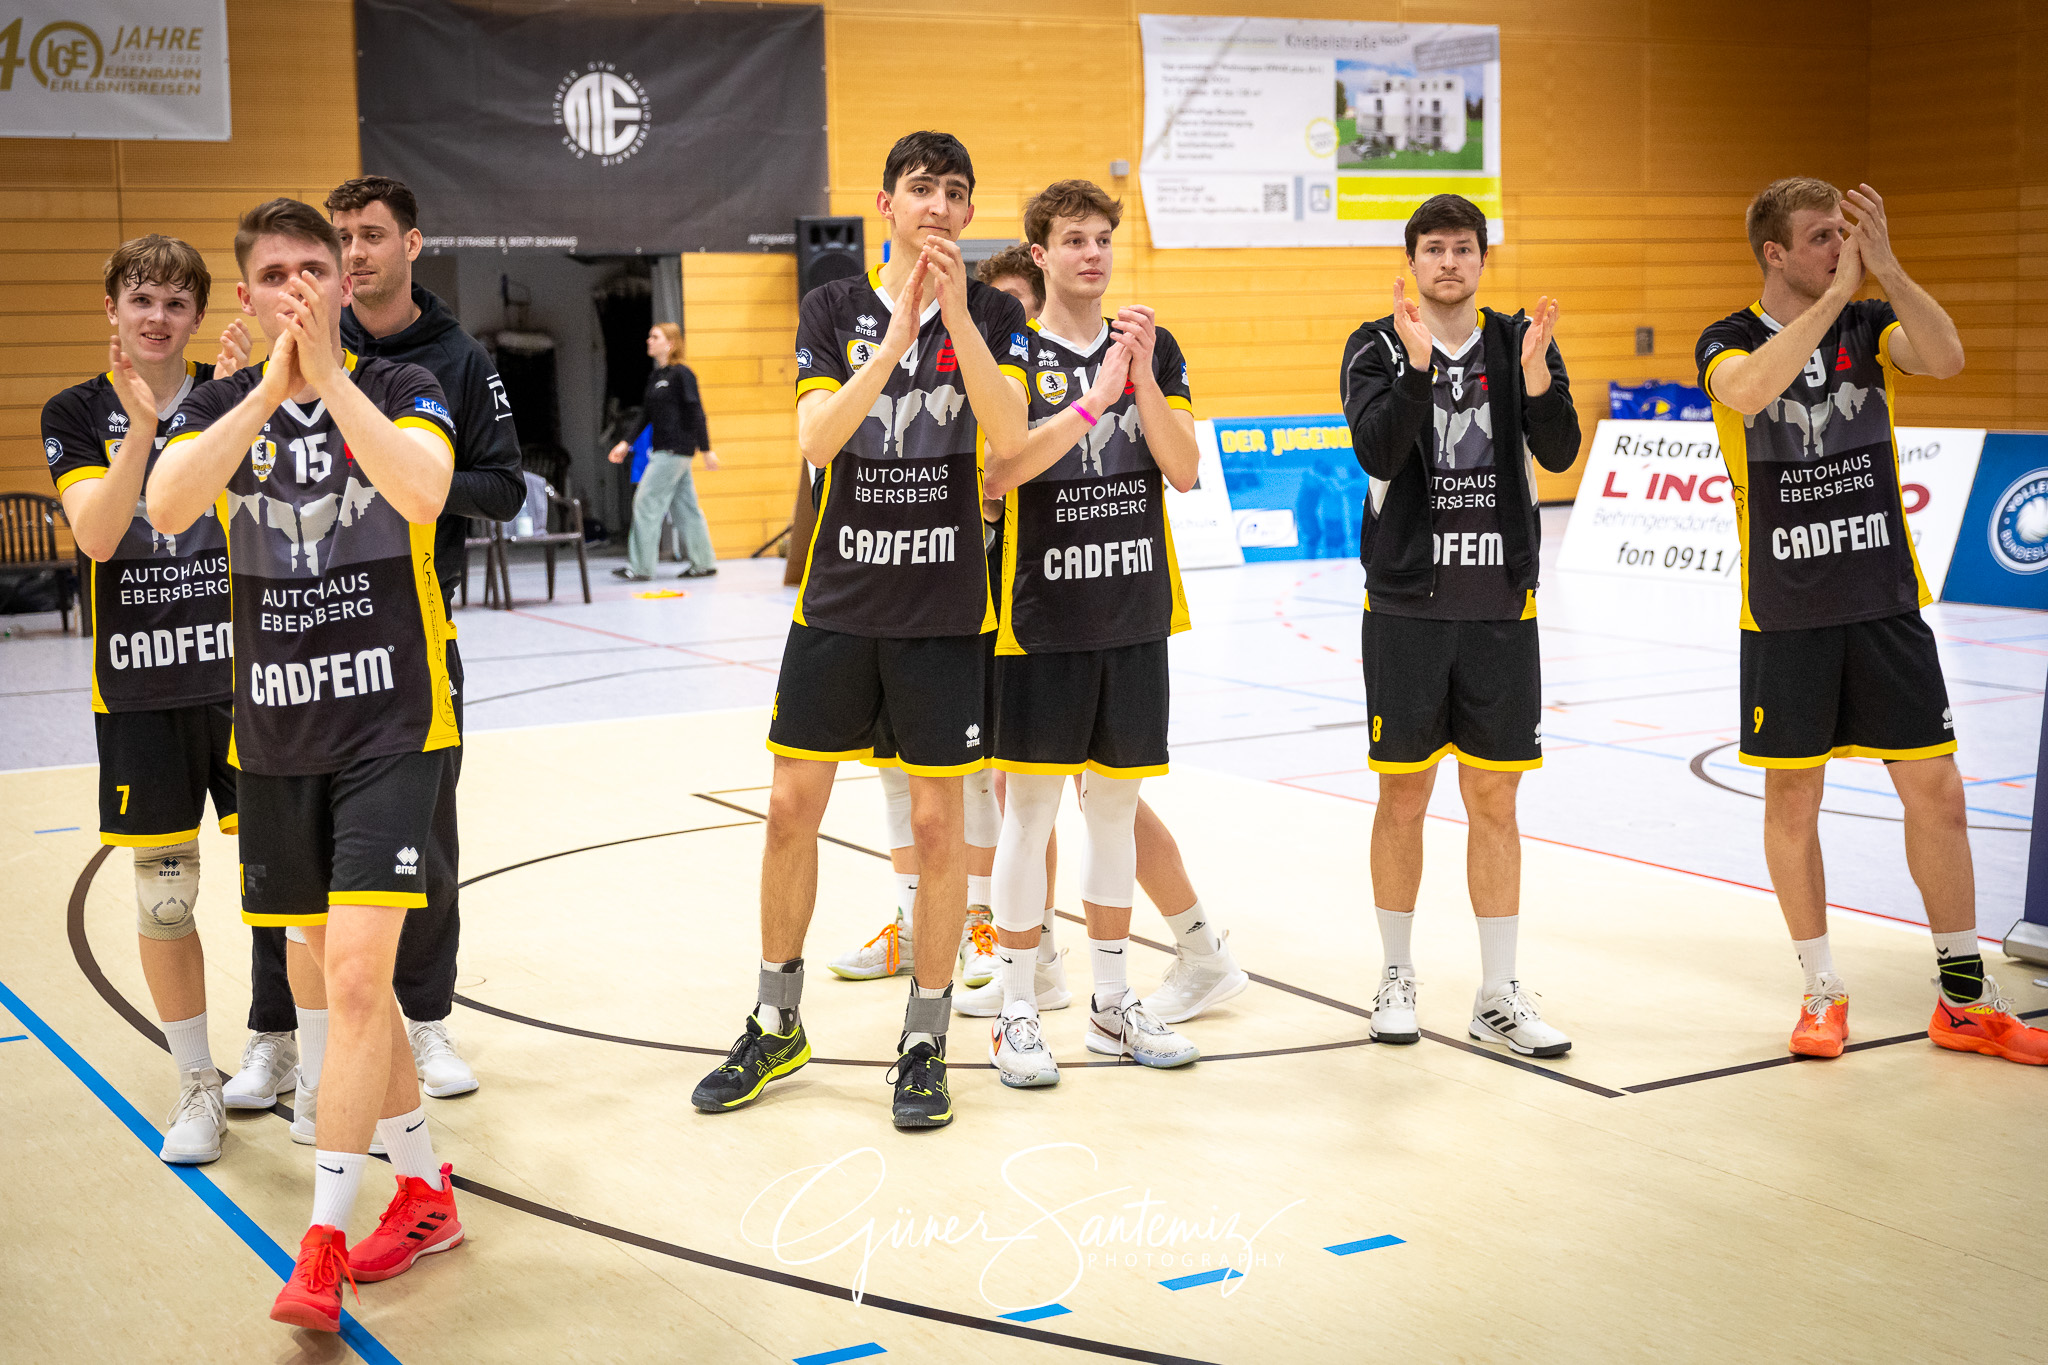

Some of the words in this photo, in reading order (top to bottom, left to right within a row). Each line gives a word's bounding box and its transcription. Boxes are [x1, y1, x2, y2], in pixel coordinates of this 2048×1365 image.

[111, 25, 203, 55] JAHRE
[104, 66, 201, 79] EISENBAHN
[50, 79, 201, 96] ERLEBNISREISEN
[855, 325, 877, 337] errea
[898, 338, 919, 377] 4
[1804, 348, 1827, 388] 9
[1220, 429, 1267, 454] DER
[288, 433, 333, 484] 15
[1780, 453, 1872, 484] AUTOHAUS
[857, 464, 949, 484] AUTOHAUS
[855, 485, 948, 504] EBERSBERG
[1056, 479, 1147, 504] AUTOHAUS
[1780, 474, 1875, 503] EBERSBERG
[1056, 498, 1147, 523] EBERSBERG
[1616, 541, 1655, 567] fon
[120, 556, 228, 584] AUTOHAUS
[121, 578, 230, 605] EBERSBERG
[1372, 715, 1383, 743] 8
[1753, 706, 1764, 734] 9
[116, 785, 130, 815] 7
[159, 869, 181, 877] errea
